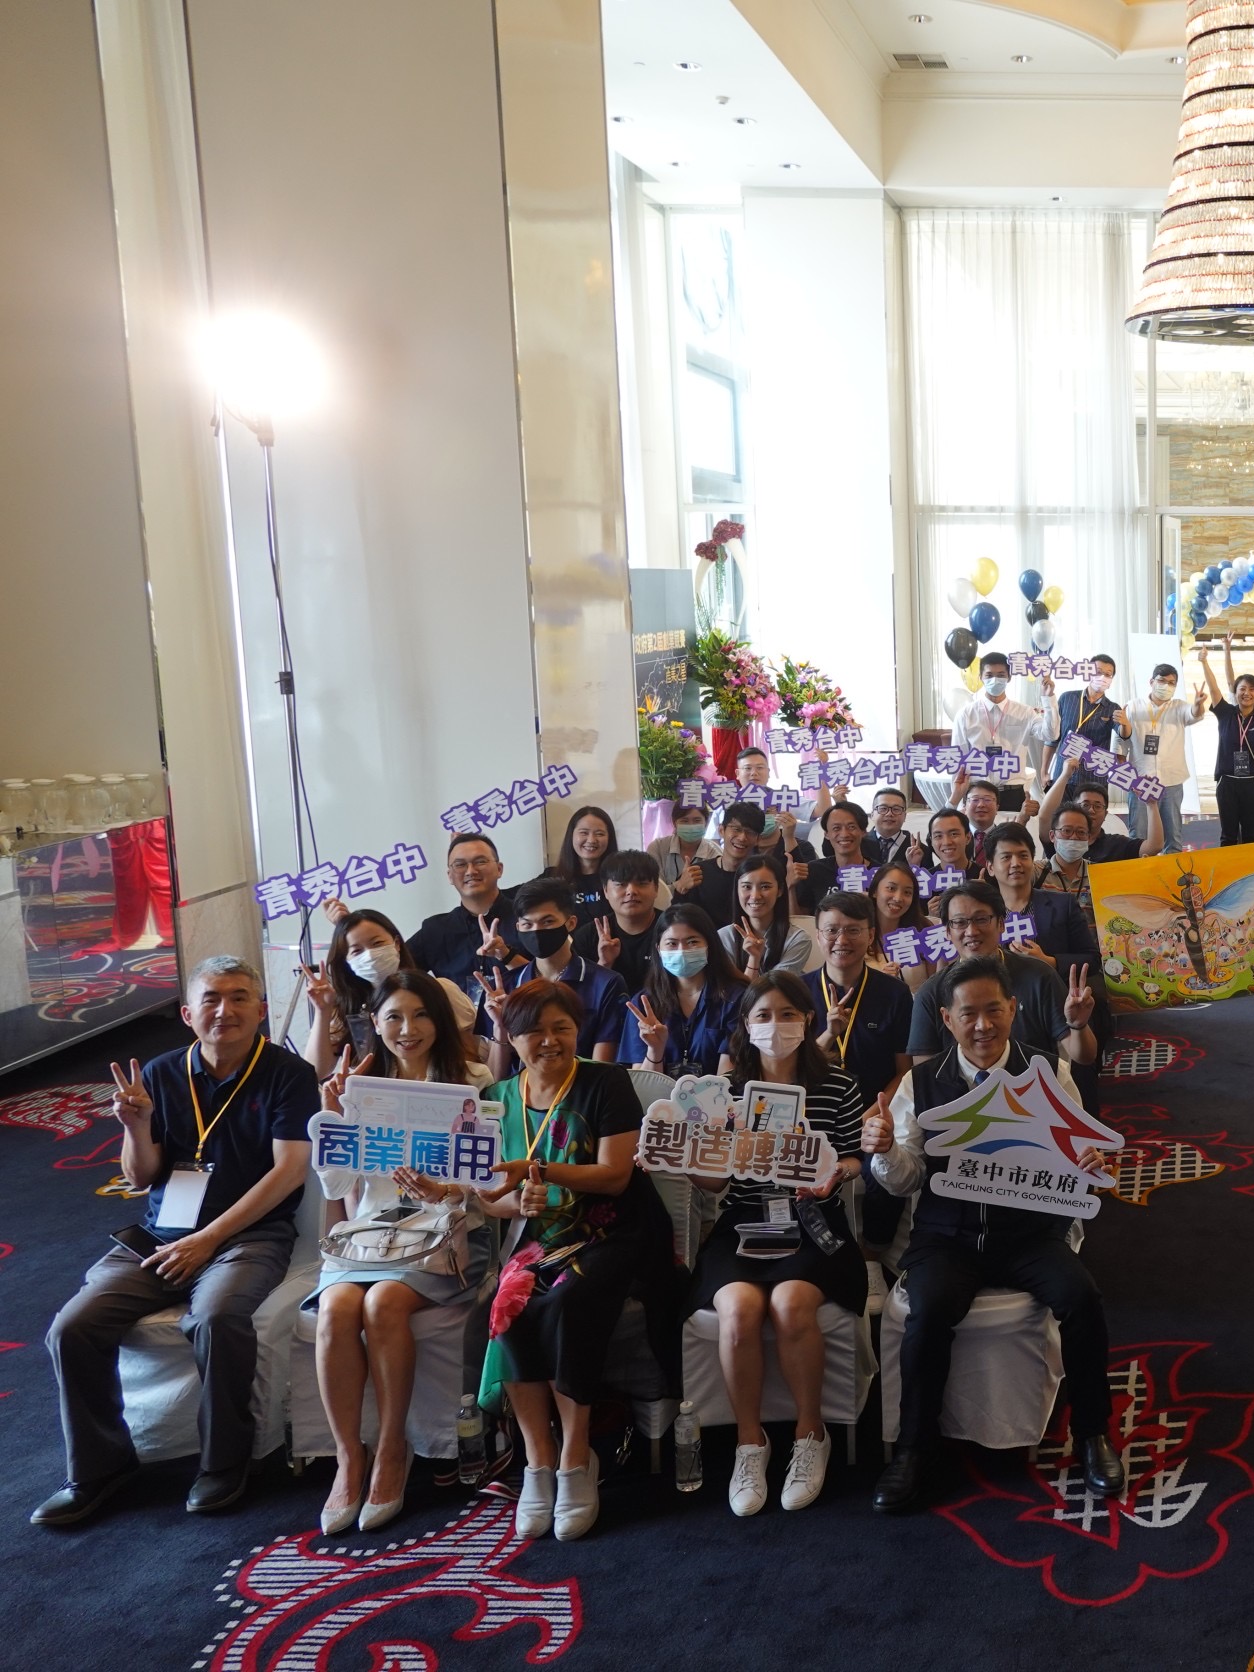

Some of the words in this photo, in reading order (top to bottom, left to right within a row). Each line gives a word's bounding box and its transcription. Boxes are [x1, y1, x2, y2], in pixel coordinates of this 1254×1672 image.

[1009, 652, 1098, 681] 青秀台中
[766, 726, 861, 753] 青秀台中
[800, 757, 905, 790] 青秀台中
[906, 744, 1019, 779] 青秀台中
[1063, 733, 1164, 802] 青秀台中
[443, 766, 577, 834] 青秀台中
[259, 846, 425, 916] 青秀台中
[839, 867, 964, 896] 青台中
[887, 917, 1034, 965] 青秀中
[318, 1122, 496, 1182] 商業應用
[644, 1120, 821, 1182] 製造轉型
[957, 1158, 1078, 1194] 臺中市政府
[941, 1180, 993, 1194] TAICHUNG
[996, 1188, 1019, 1197] CITY
[1021, 1192, 1094, 1209] GOVERNMENT
